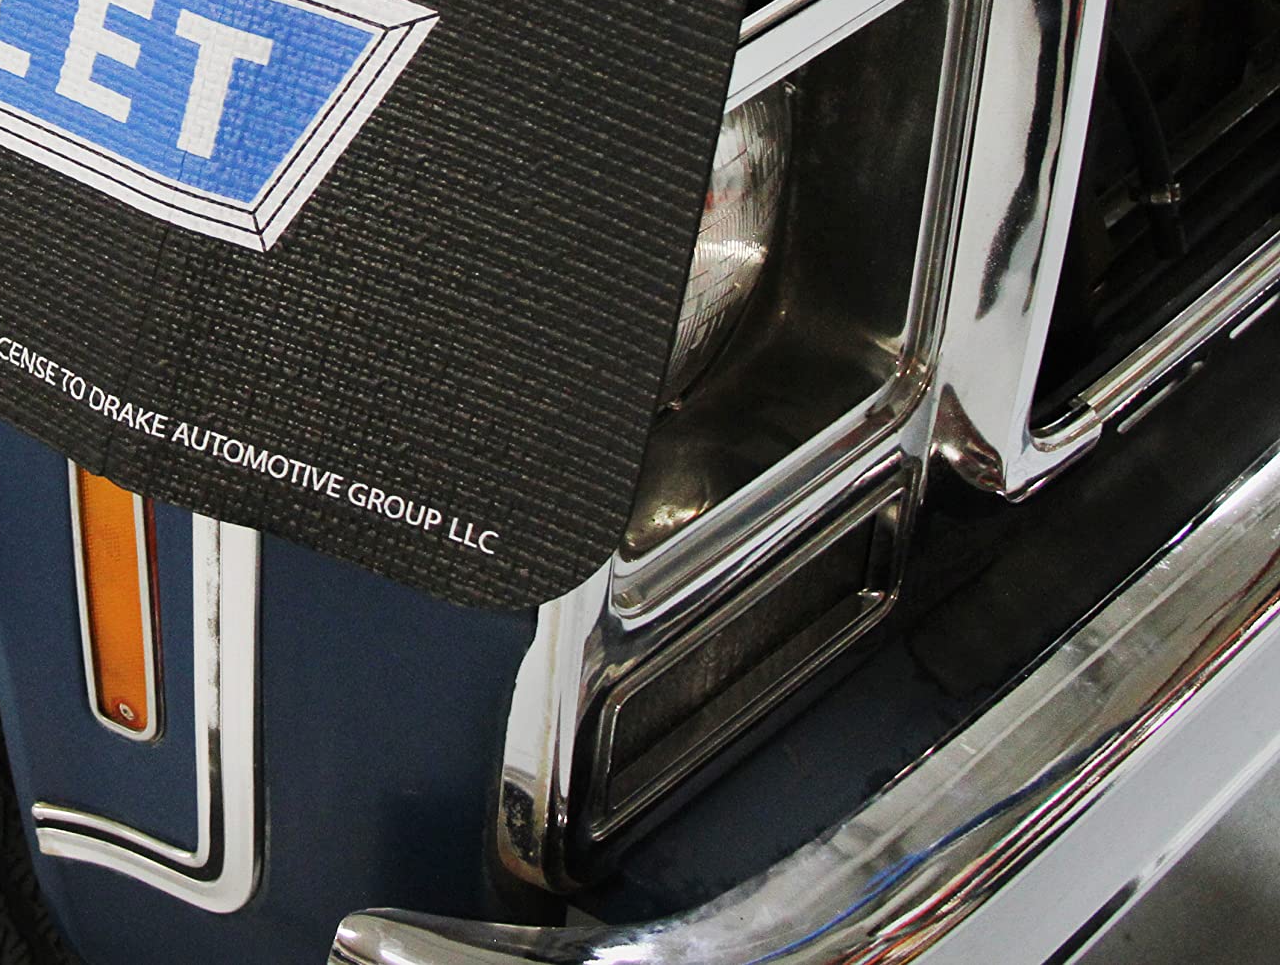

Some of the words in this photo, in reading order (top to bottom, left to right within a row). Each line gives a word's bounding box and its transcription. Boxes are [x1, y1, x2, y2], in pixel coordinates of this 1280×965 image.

[60, 367, 87, 400] TO
[88, 385, 169, 438] DRAKE
[171, 422, 344, 498] AUTOMOTIVE
[347, 482, 442, 530] GROUP
[448, 517, 499, 555] LLC
